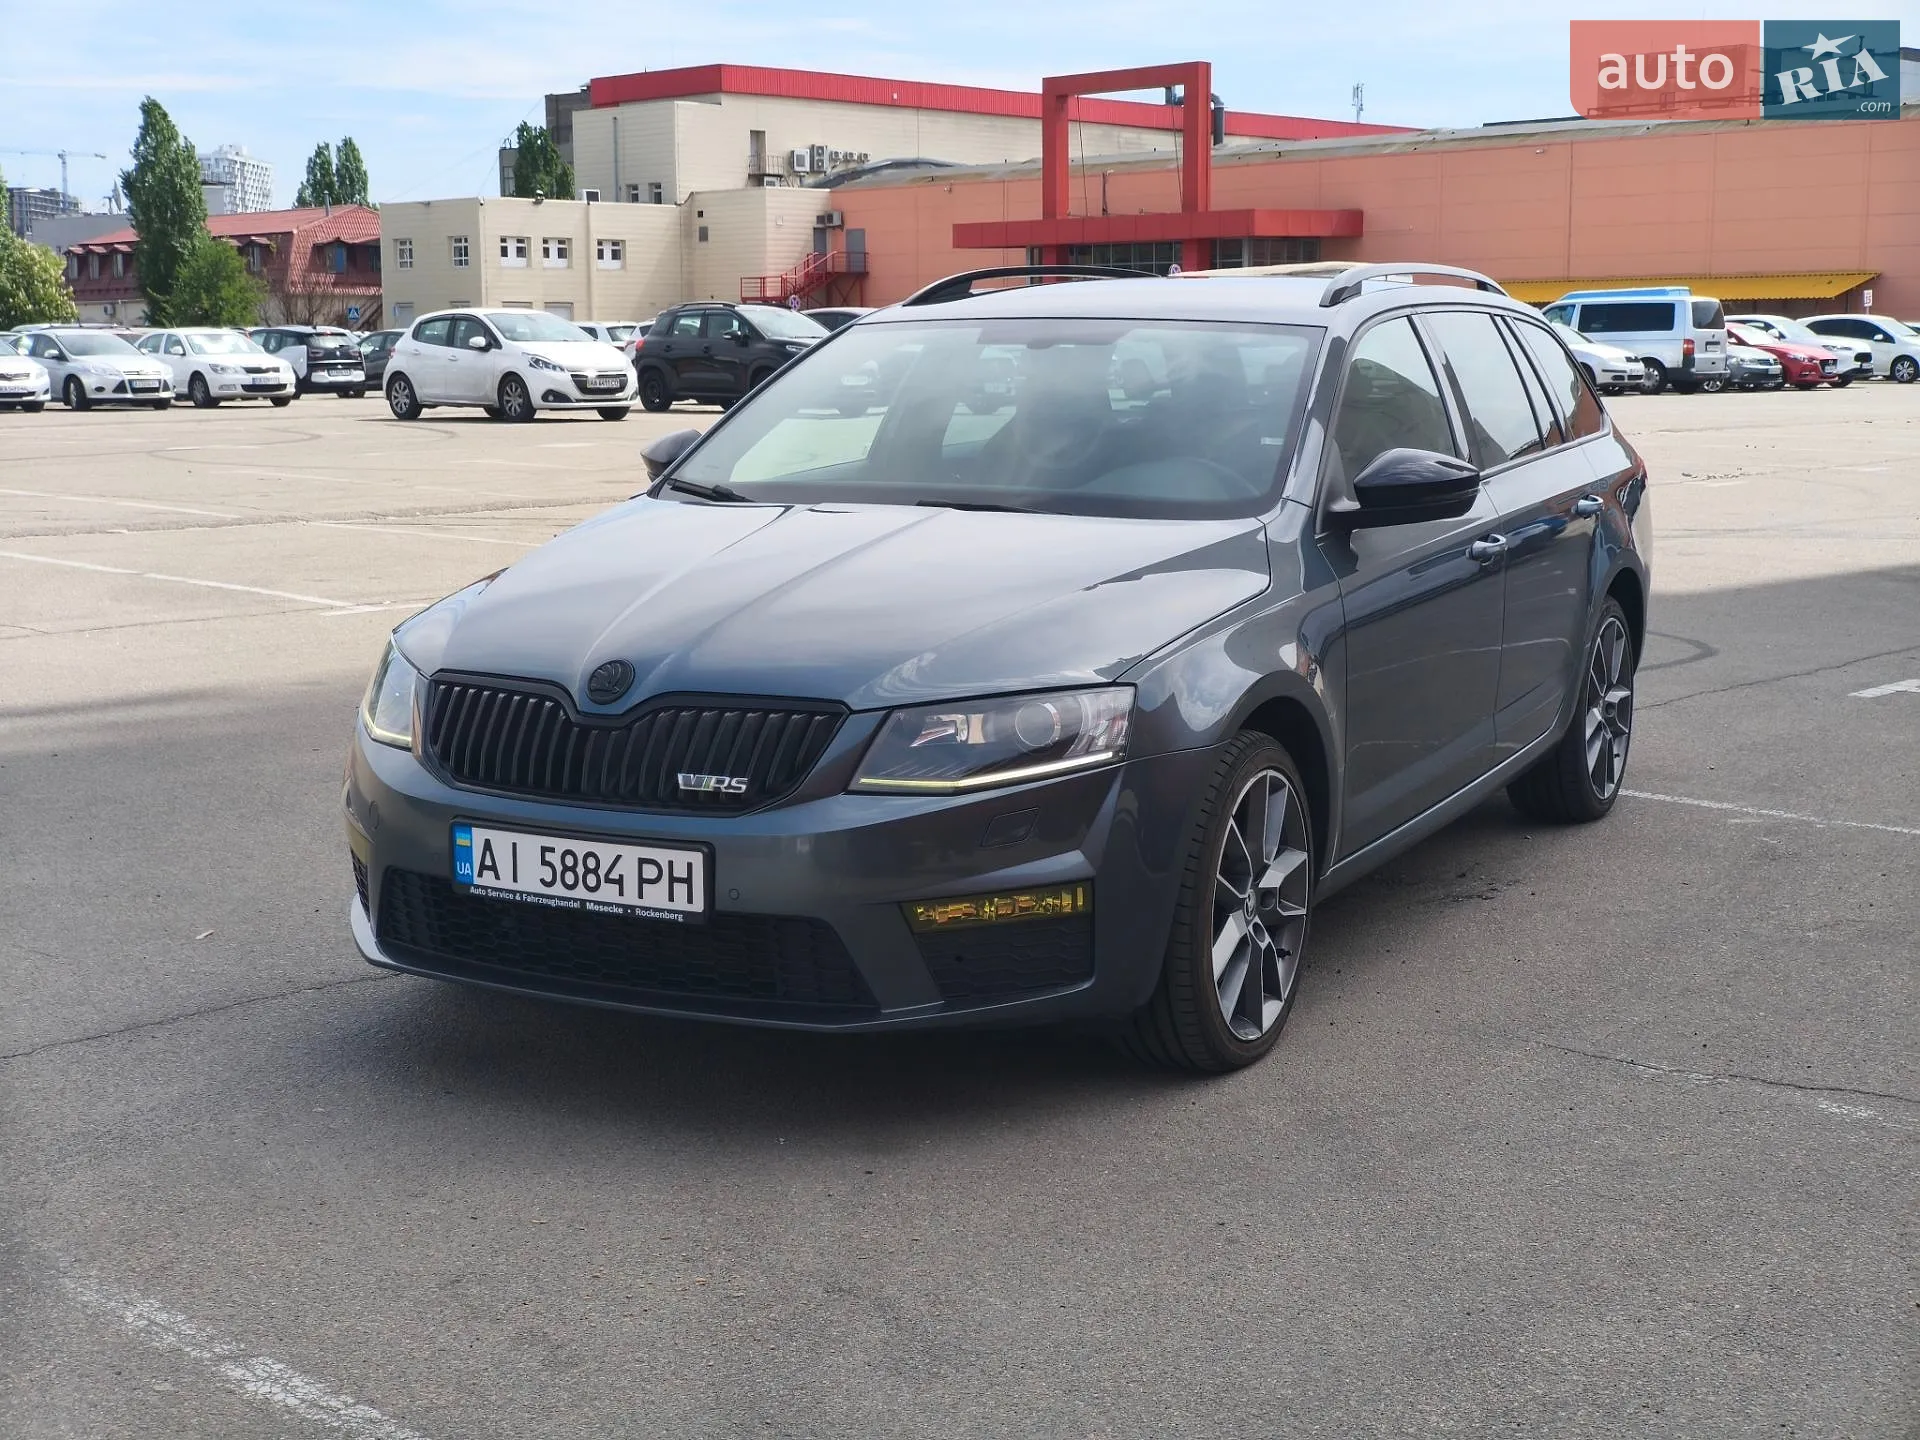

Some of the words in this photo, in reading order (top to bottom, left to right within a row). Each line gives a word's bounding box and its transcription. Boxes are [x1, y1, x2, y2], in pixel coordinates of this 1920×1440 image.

[457, 862, 472, 876] UA
[476, 838, 519, 884] AI
[470, 886, 486, 896] Auto
[487, 888, 514, 900] Service
[515, 892, 521, 901] &
[522, 893, 581, 909] Fahrzeughandel
[635, 907, 685, 922] Rockenberg
